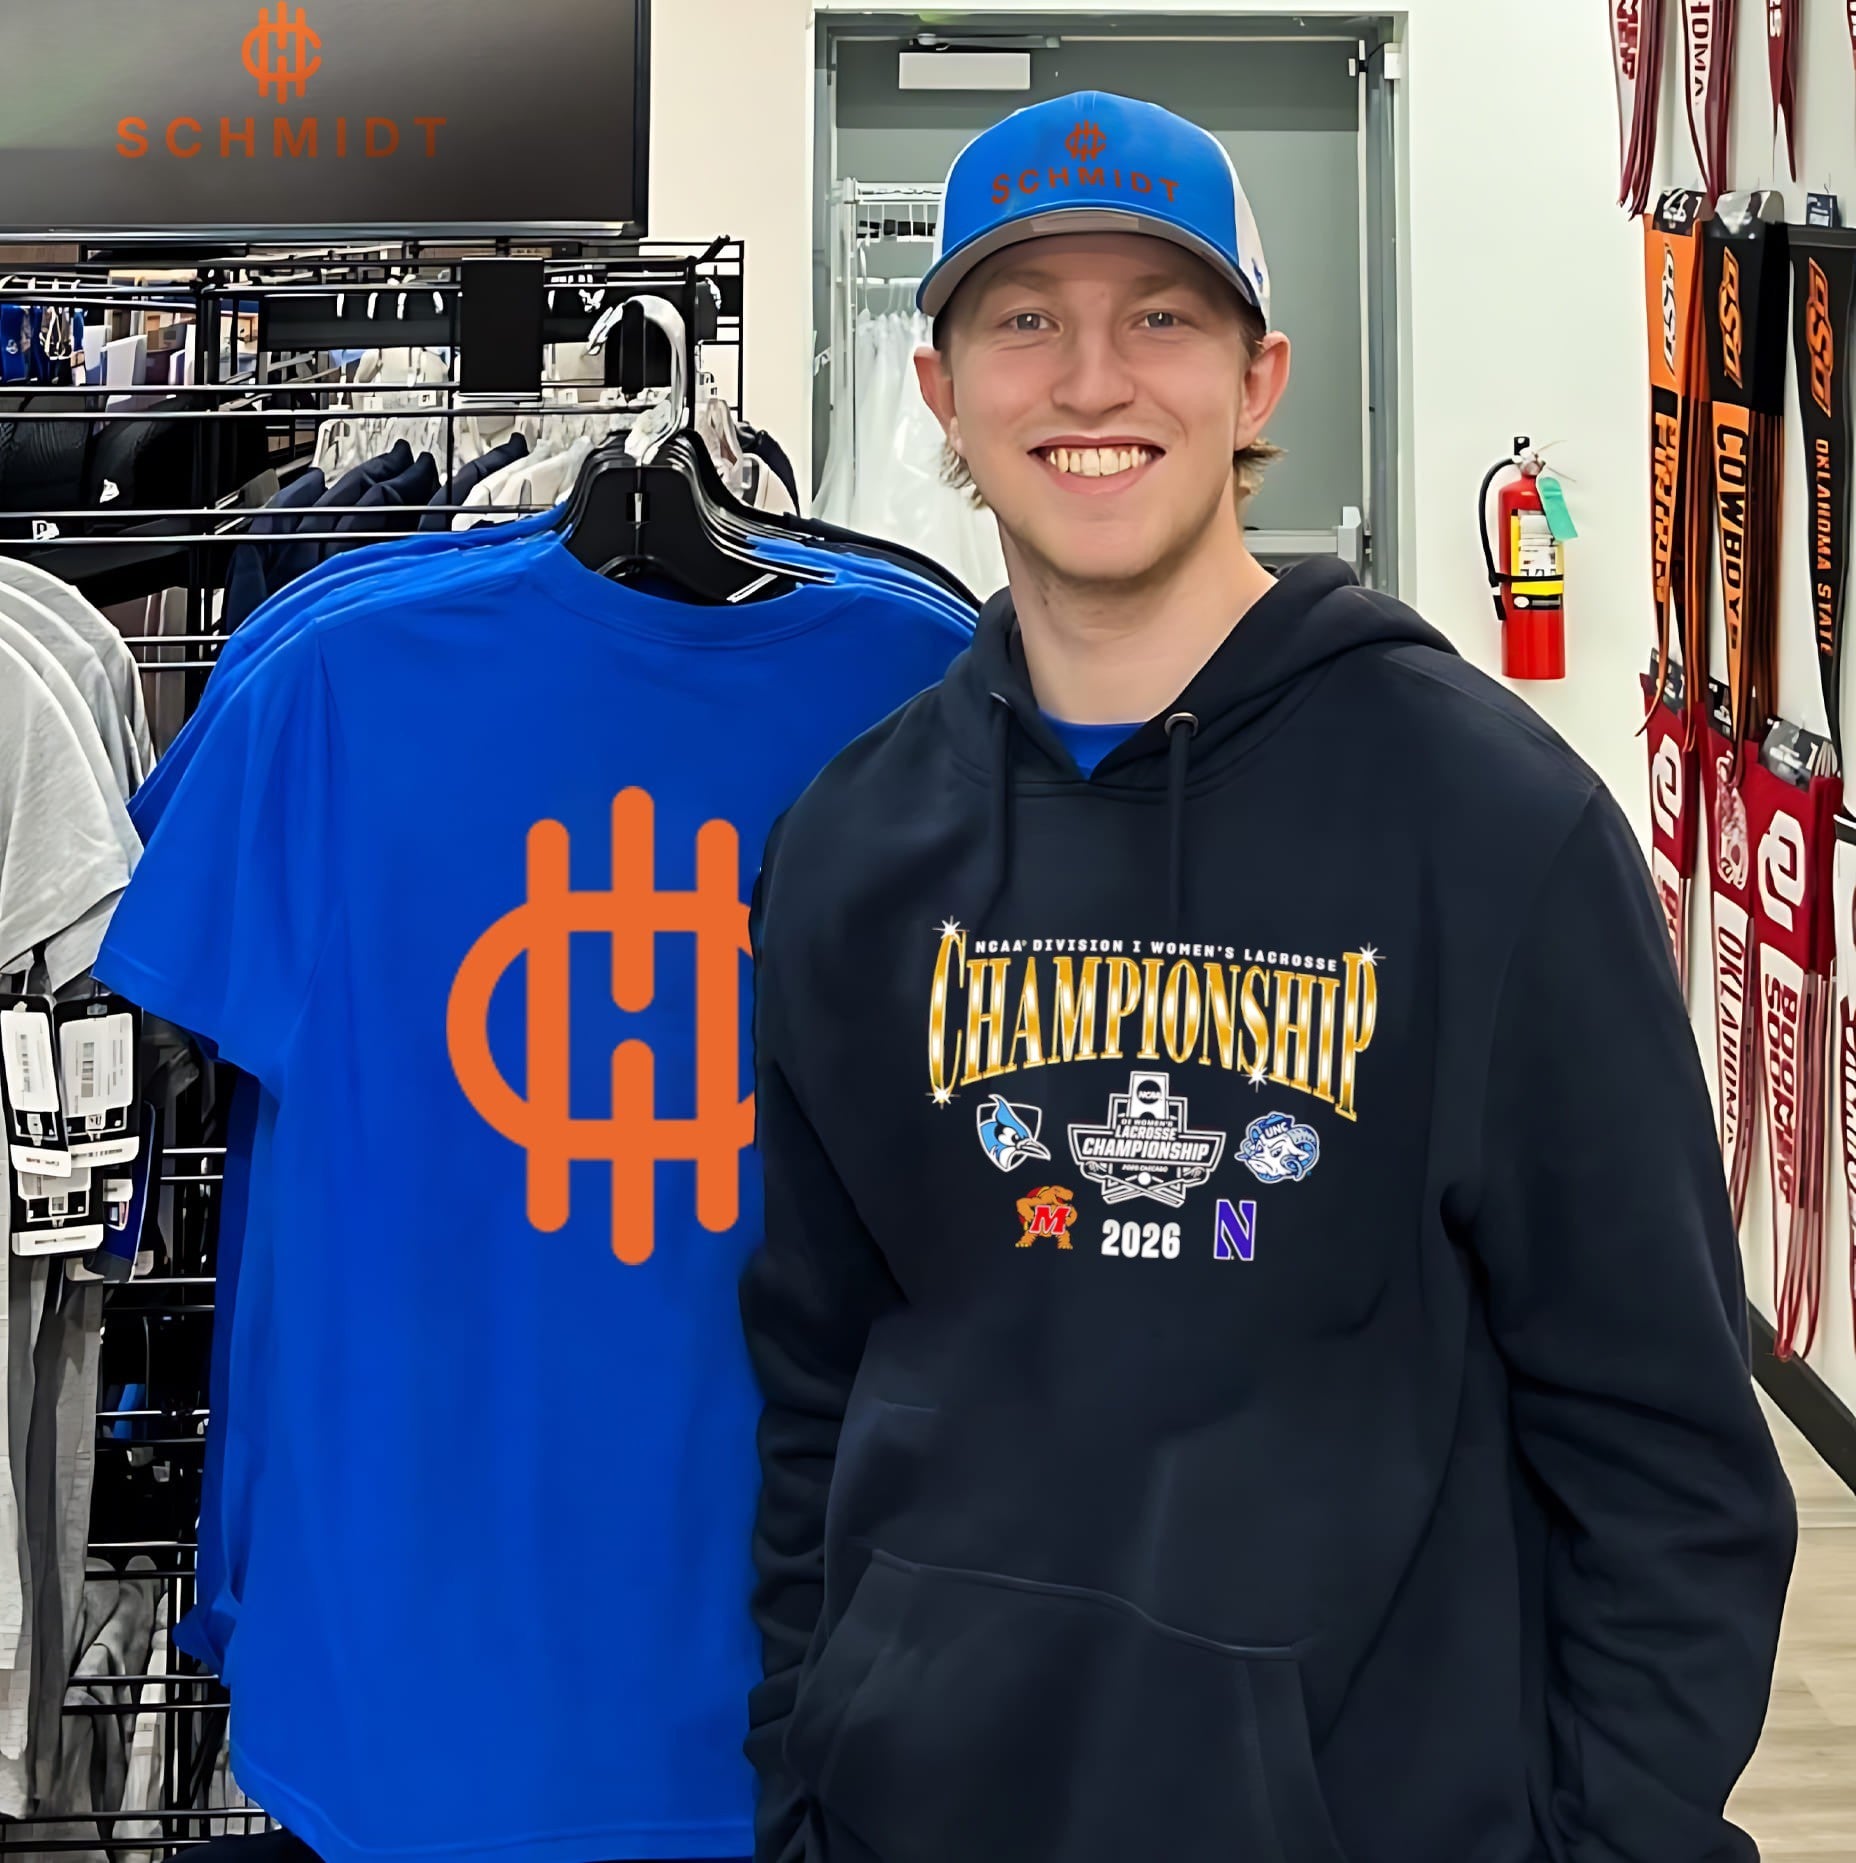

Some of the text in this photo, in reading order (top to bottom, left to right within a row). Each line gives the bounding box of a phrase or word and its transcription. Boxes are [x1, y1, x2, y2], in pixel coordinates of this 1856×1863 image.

[115, 116, 447, 158] SCHMIDT
[991, 166, 1180, 205] SCHMIDT
[974, 938, 1338, 972] NCAA DIVISION I WOMEN'S LACROSSE
[928, 929, 1378, 1122] CHAMPIONSHIP
[1114, 1124, 1178, 1141] LACROSSE
[1265, 1122, 1289, 1138] UNC
[1082, 1136, 1210, 1161] CHAMPIONSHIP
[1029, 1204, 1071, 1235] M
[1213, 1198, 1257, 1262] N
[1101, 1218, 1181, 1260] 2026
